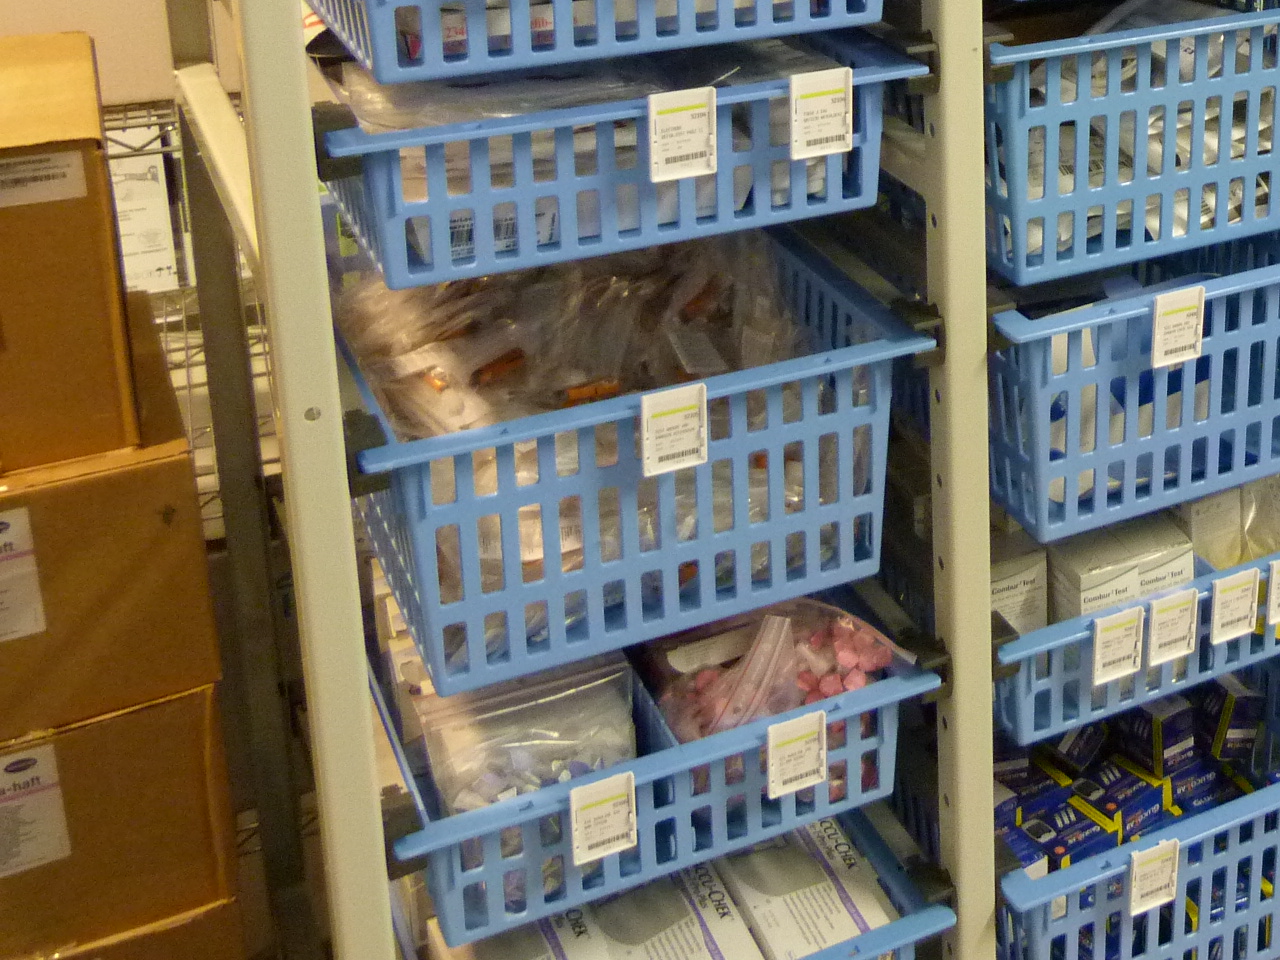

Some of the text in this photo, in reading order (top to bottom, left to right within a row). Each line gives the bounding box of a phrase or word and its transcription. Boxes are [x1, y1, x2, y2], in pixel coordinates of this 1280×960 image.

[1170, 569, 1184, 579] Test
[1022, 577, 1036, 587] Test
[1114, 586, 1128, 596] Test
[819, 819, 857, 870] CCU-CHEK
[695, 863, 732, 919] CCU-CHEK
